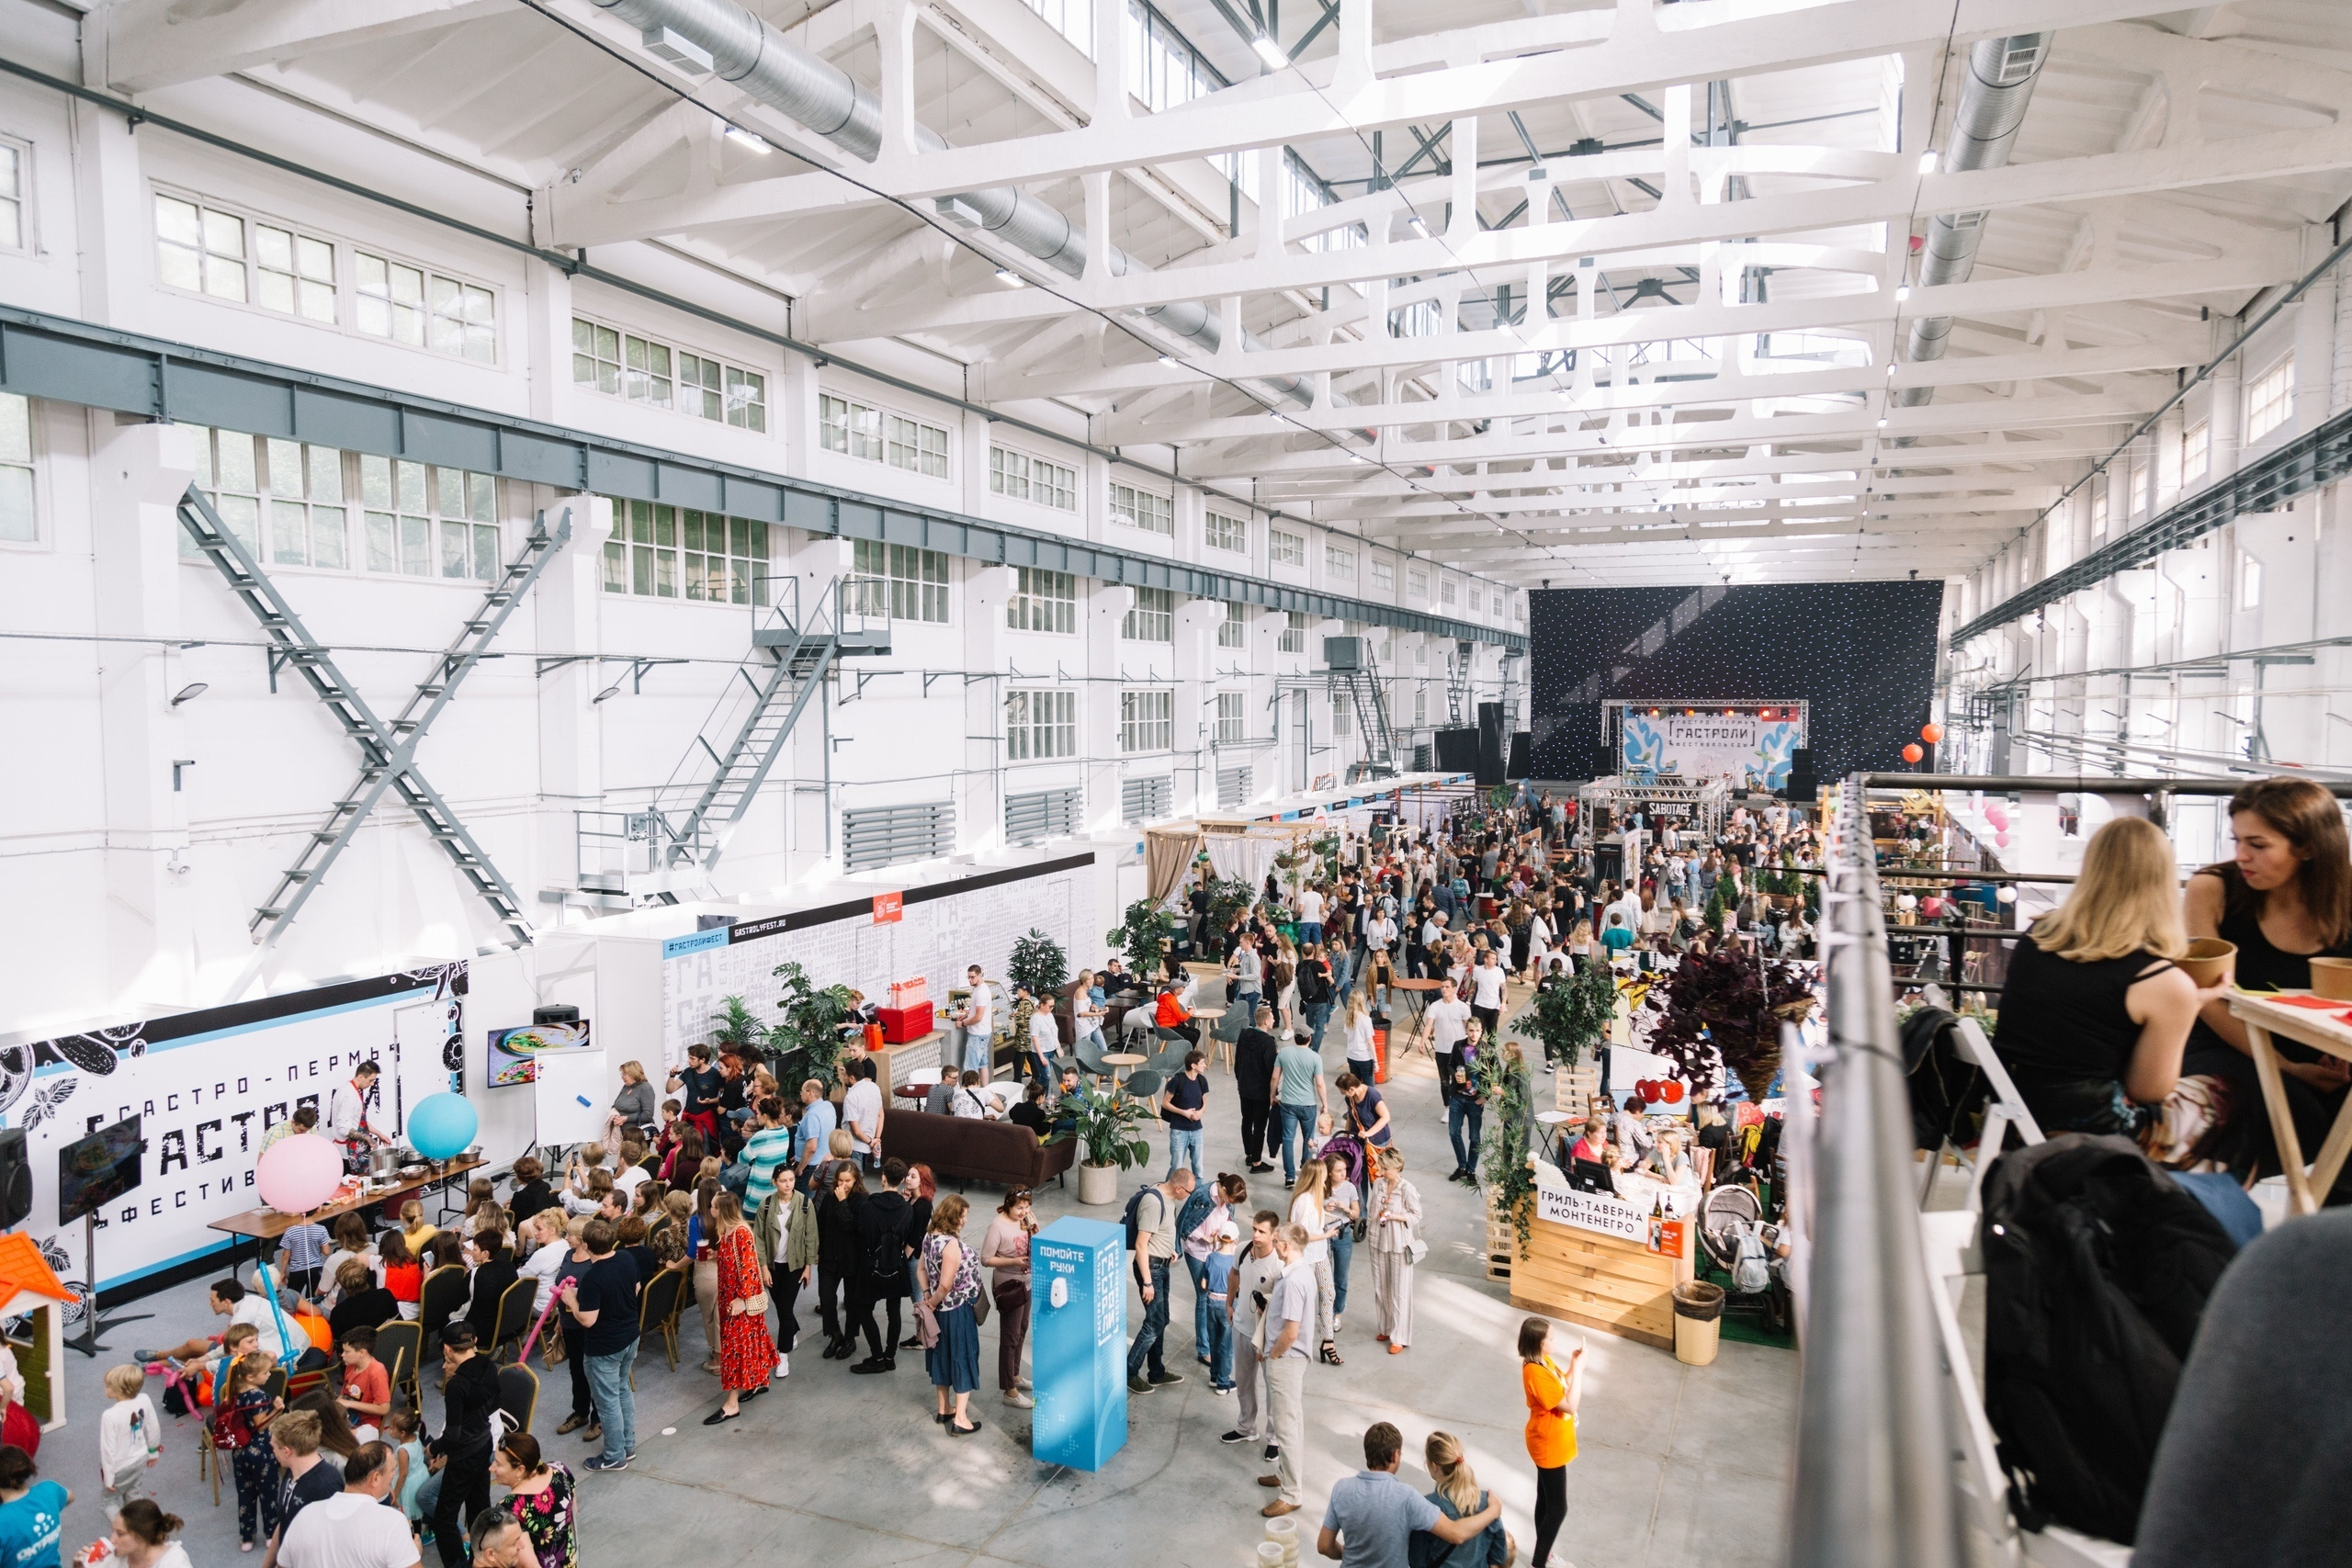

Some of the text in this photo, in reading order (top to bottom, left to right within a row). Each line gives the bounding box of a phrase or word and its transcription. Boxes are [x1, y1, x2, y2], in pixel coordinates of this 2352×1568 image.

[1676, 728, 1748, 739] ГАСТРОЛИ
[1648, 802, 1692, 817] SABOTAGE
[734, 919, 786, 937] GASTROLYFEST.RU
[669, 933, 723, 952] #ГАСТРОЛИФЕСТ
[121, 1169, 255, 1224] ФЕСТИВ
[1549, 1206, 1634, 1234] МОНТЕНЕГРО
[1039, 1246, 1084, 1263] ПОМОЙТЕ
[1050, 1261, 1075, 1274] РУКИ
